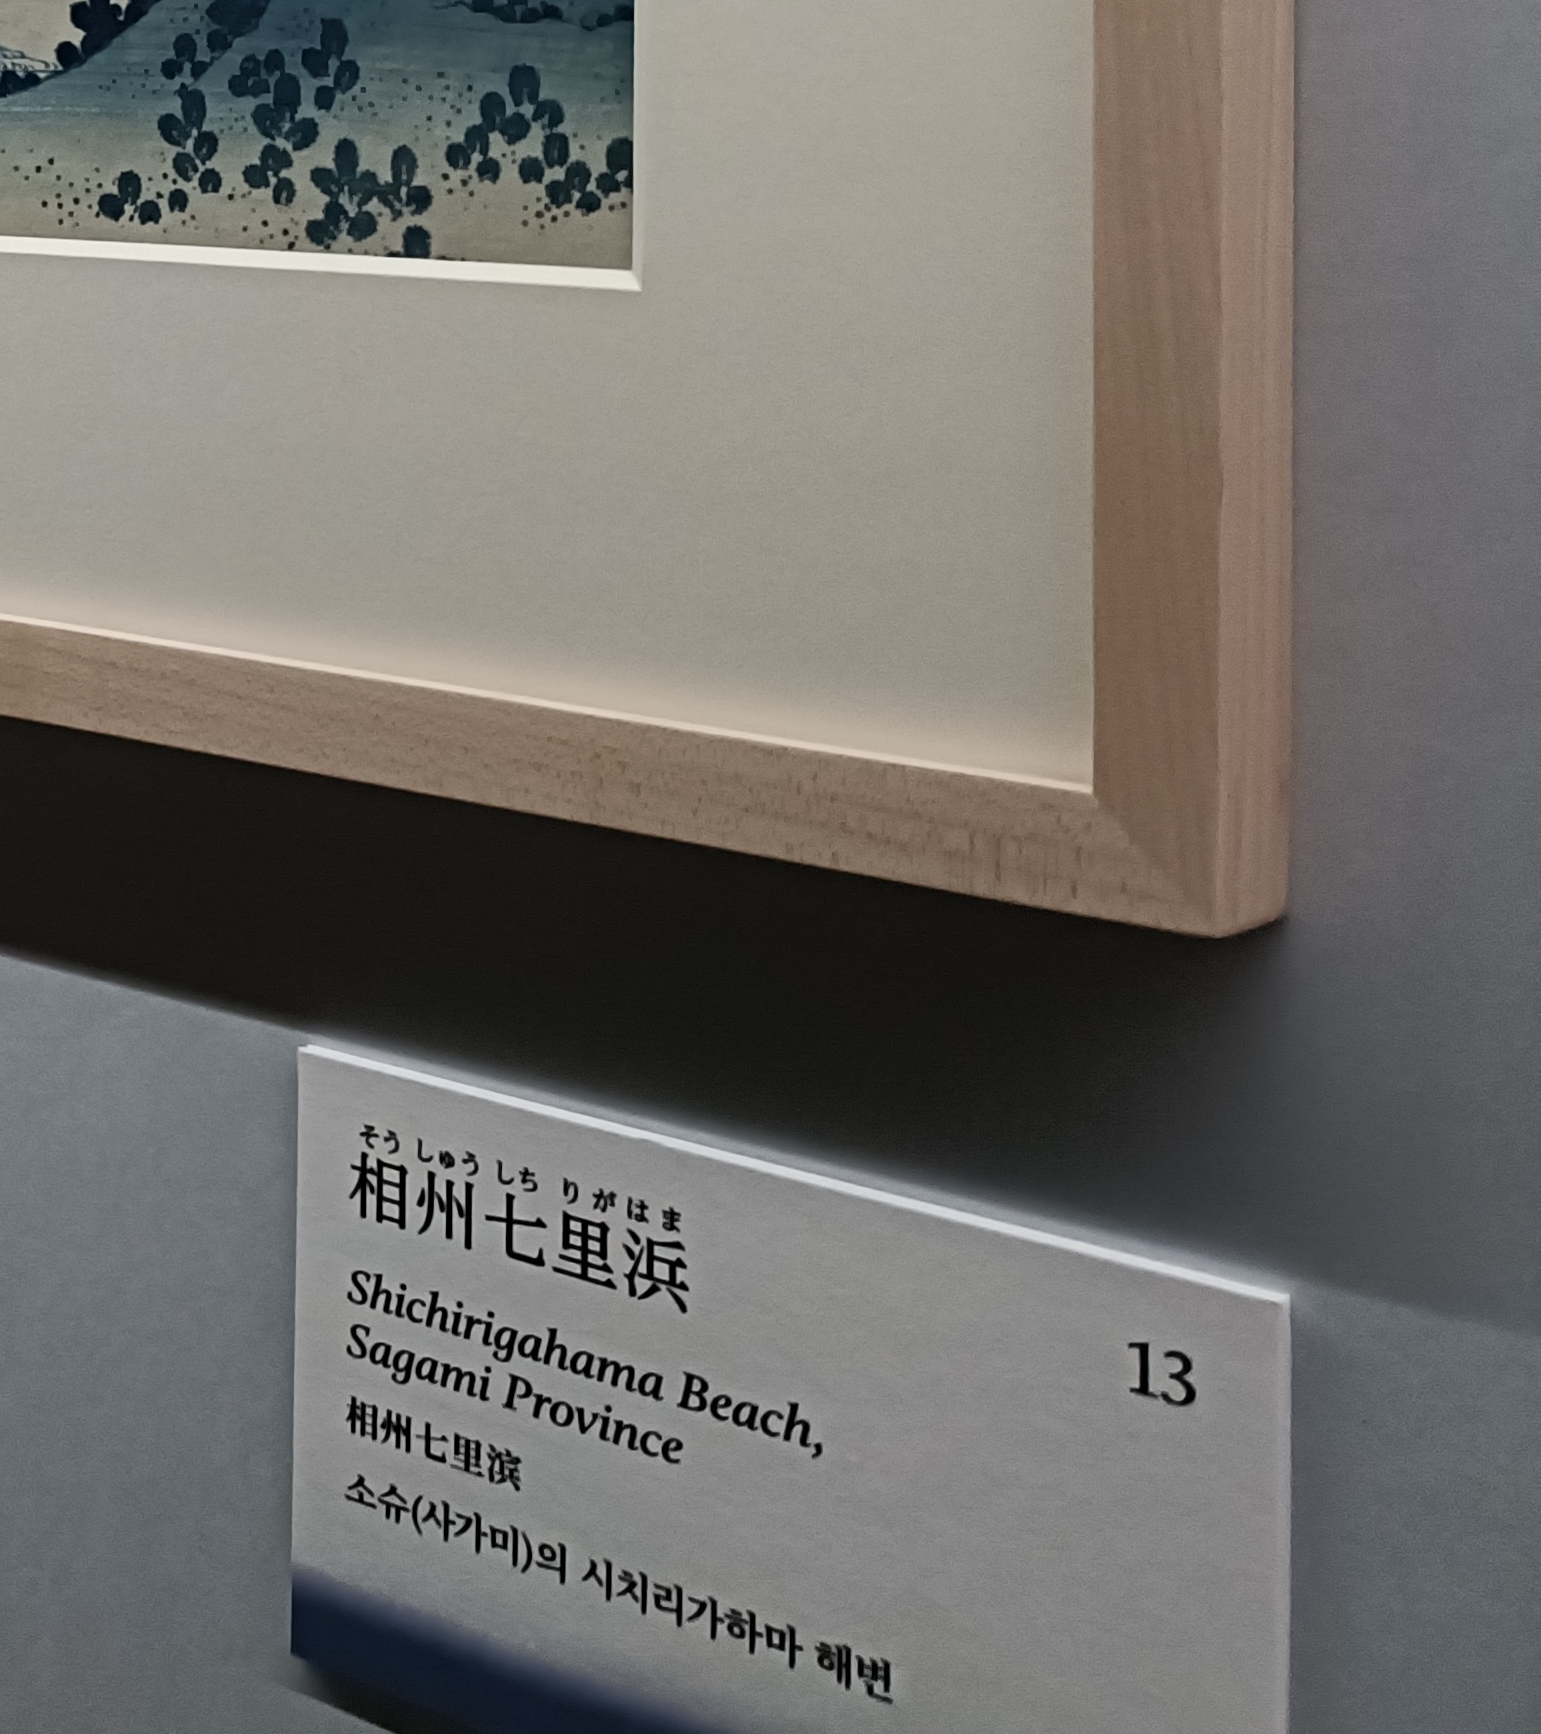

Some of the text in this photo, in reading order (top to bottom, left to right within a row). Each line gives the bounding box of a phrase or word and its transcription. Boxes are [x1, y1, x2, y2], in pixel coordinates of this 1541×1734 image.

[349, 1151, 690, 1314] 相州七里浜
[346, 1324, 685, 1464] Sagami Province
[347, 1270, 824, 1460] Shichirigahama Beach,
[1126, 1341, 1198, 1406] 13
[345, 1395, 524, 1492] 相州七里滨
[344, 1474, 894, 1705] 소슈(사가미)의 시치리가하마 해변
